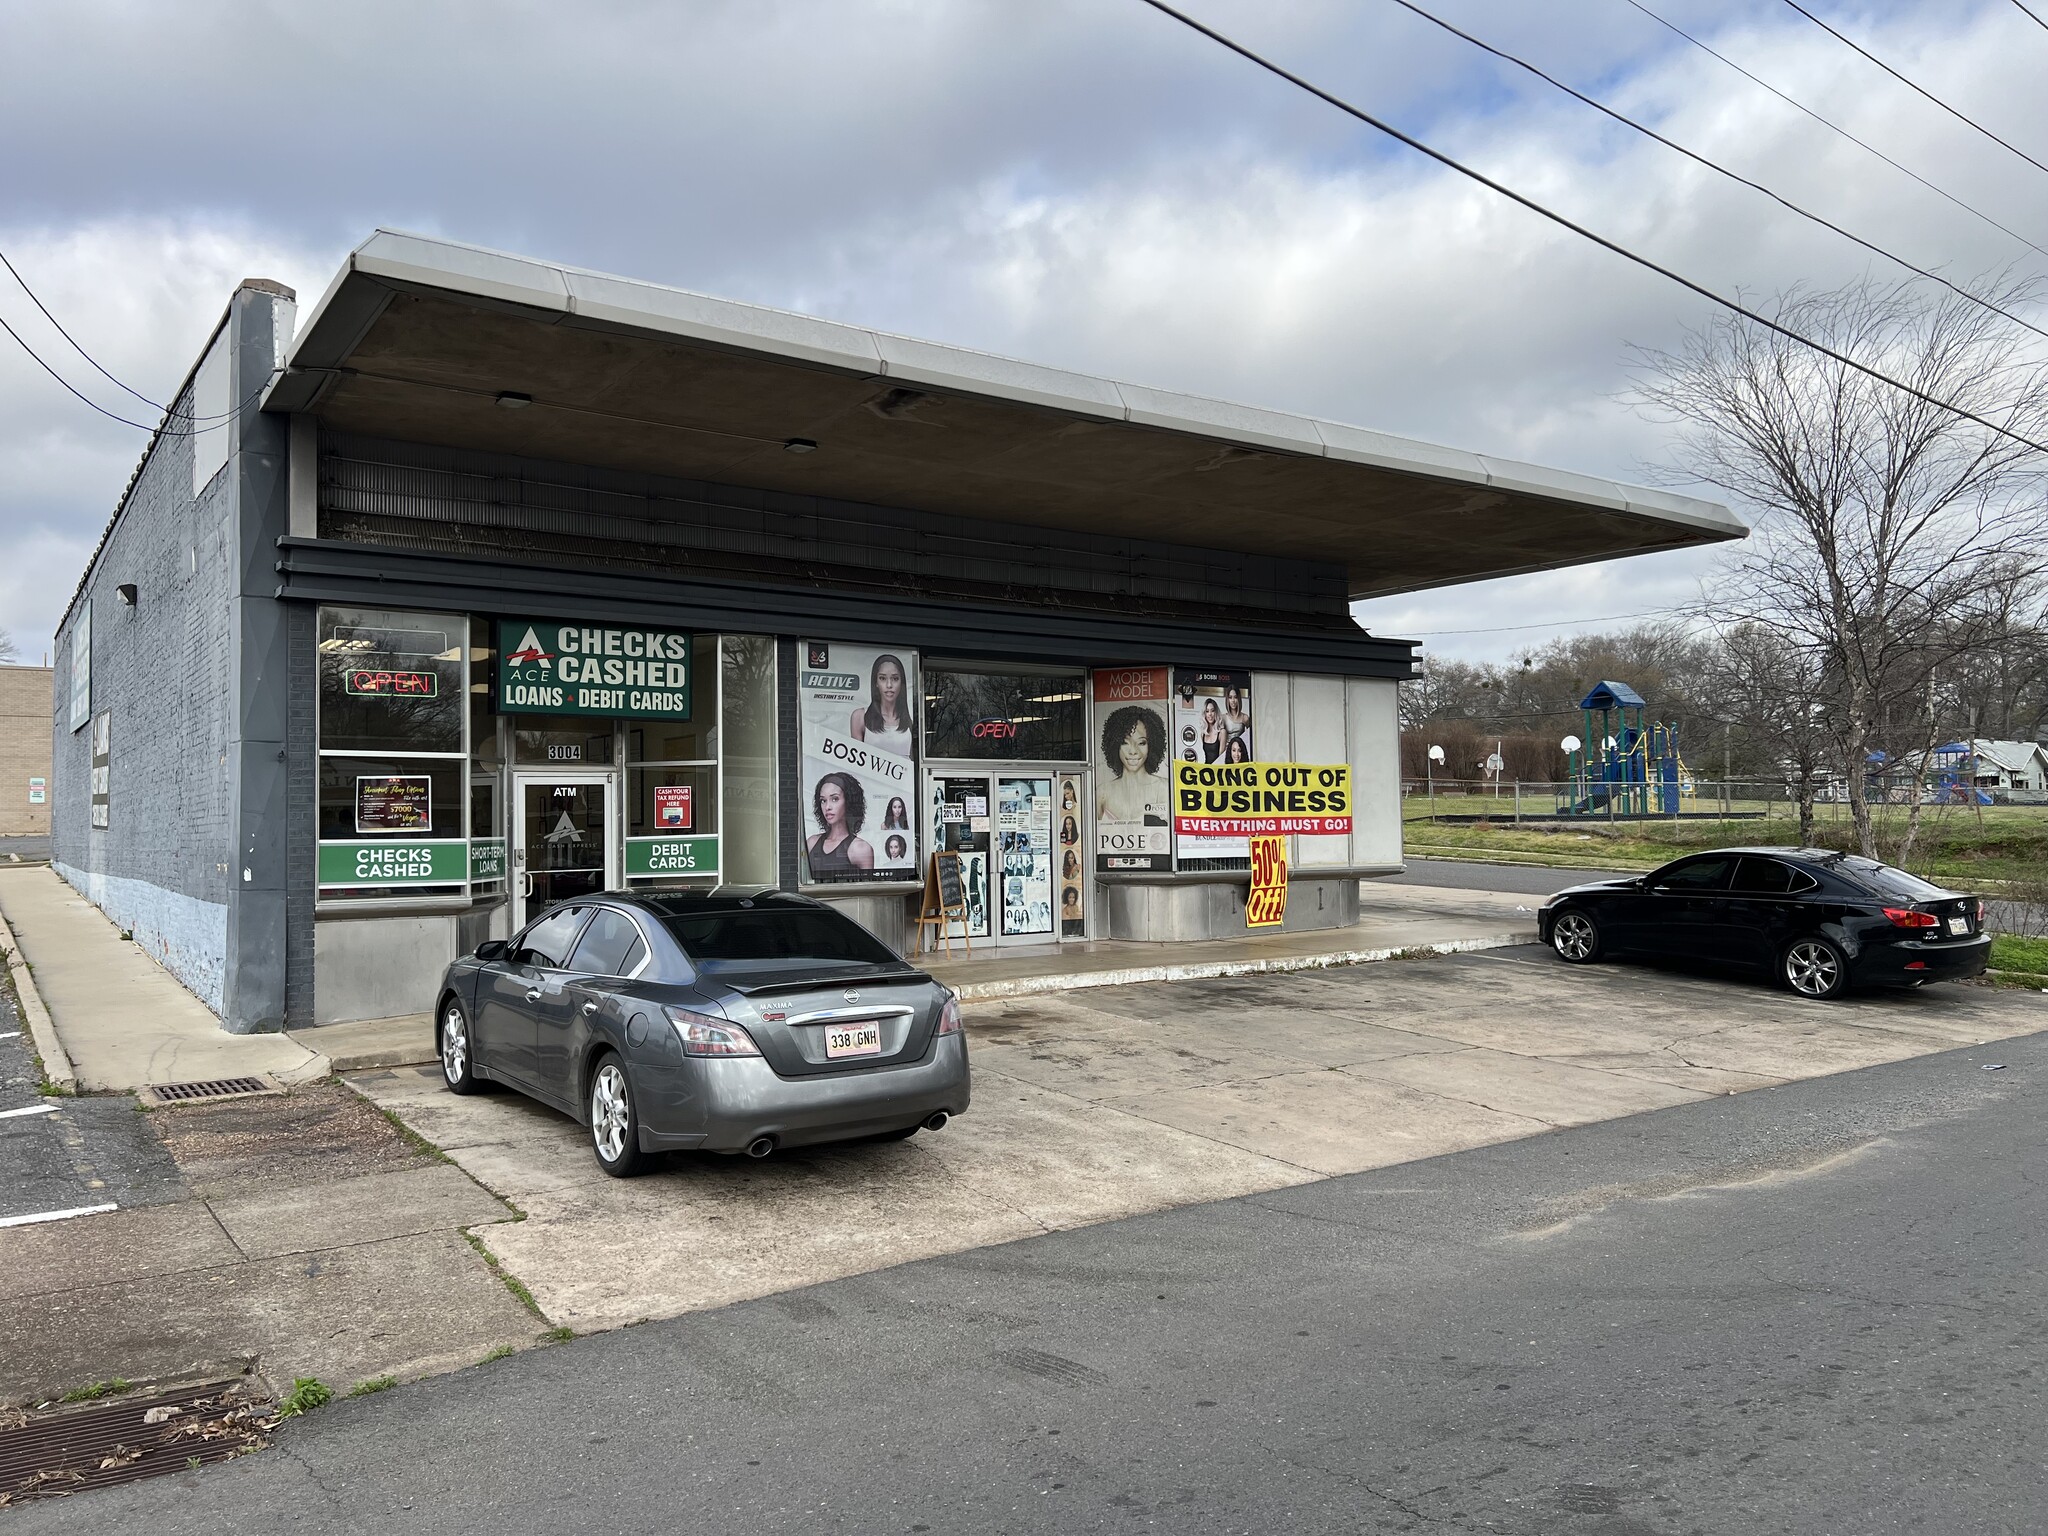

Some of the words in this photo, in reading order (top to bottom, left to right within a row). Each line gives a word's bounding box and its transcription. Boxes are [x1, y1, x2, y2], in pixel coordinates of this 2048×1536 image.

[557, 626, 686, 660] CHECKS
[510, 669, 549, 682] ACE
[557, 656, 686, 688] CASHED
[1109, 671, 1154, 686] MODEL
[354, 672, 428, 693] OPEN
[807, 674, 855, 688] ACTIVE
[505, 684, 563, 707] LOANS
[578, 688, 625, 709] DEBIT
[630, 691, 683, 711] CARDS
[1109, 684, 1154, 698] MODEL
[973, 722, 1017, 739] OPEN
[550, 746, 580, 759] 3004
[822, 738, 867, 767] BOSS
[870, 754, 904, 781] WIG
[1180, 766, 1258, 786] GOING
[1265, 768, 1312, 787] OUT
[1318, 769, 1347, 787] OF
[554, 787, 577, 797] ATM
[1180, 789, 1347, 812] BUSINESS
[390, 805, 412, 813] $7000
[943, 809, 954, 818] 20%
[1181, 819, 1277, 831] EVERYTHING
[1280, 819, 1320, 831] MUST
[1324, 818, 1348, 830] GO!
[1100, 834, 1146, 849] POSE
[356, 848, 432, 863] CHECKS
[471, 846, 505, 860] SHORT-TERM
[652, 843, 692, 856] DEBIT
[479, 860, 498, 873] LOANS
[648, 856, 696, 869] CARDS
[1251, 838, 1286, 887] 50%
[355, 863, 433, 878] CASHED
[1249, 888, 1285, 922] Off!
[759, 1001, 793, 1010] MAXIMA
[831, 1033, 851, 1048] 338
[857, 1030, 877, 1045] GNH
